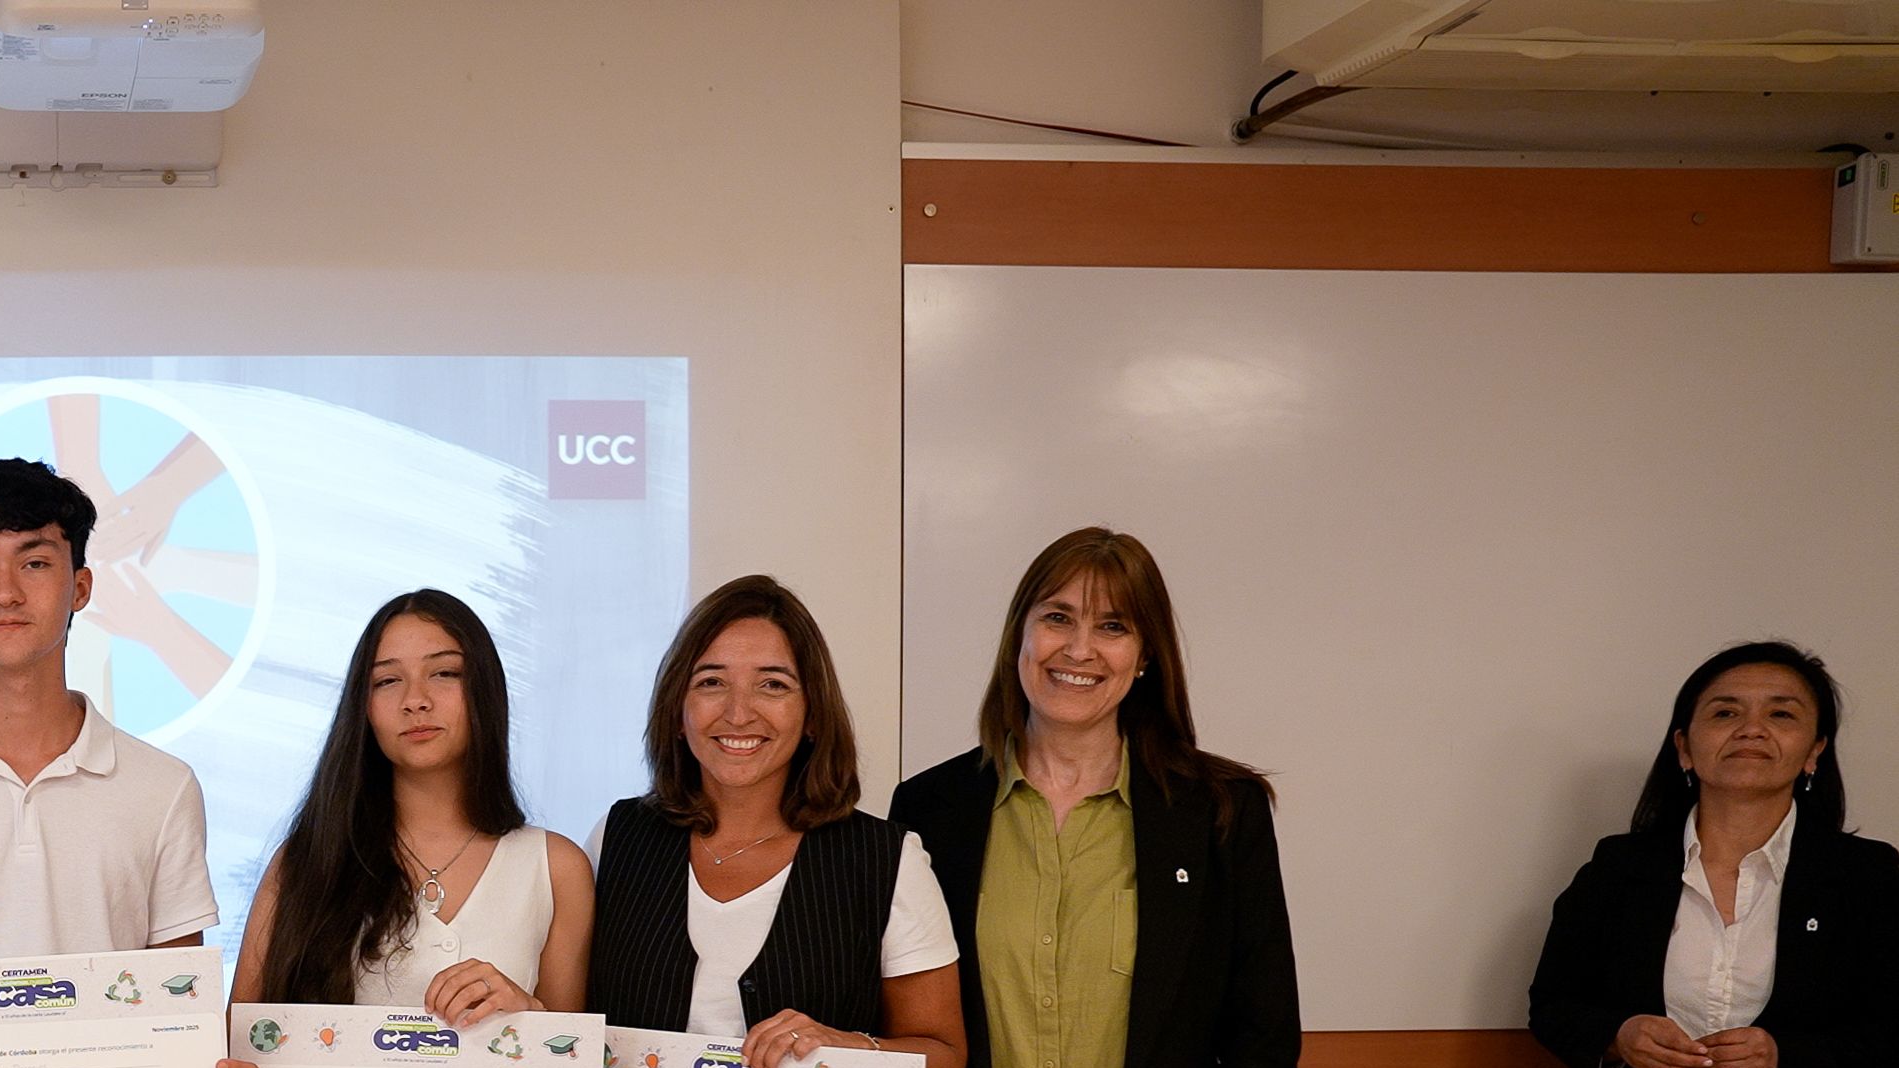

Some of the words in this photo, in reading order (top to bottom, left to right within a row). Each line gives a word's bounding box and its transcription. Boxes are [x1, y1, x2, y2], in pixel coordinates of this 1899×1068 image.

[557, 434, 636, 466] UCC
[1, 968, 48, 977] CERTAMEN
[35, 994, 74, 1007] común
[387, 1013, 433, 1022] CERTAMEN
[373, 1026, 459, 1052] casa
[8, 1048, 36, 1056] Córdoba
[417, 1043, 457, 1055] común
